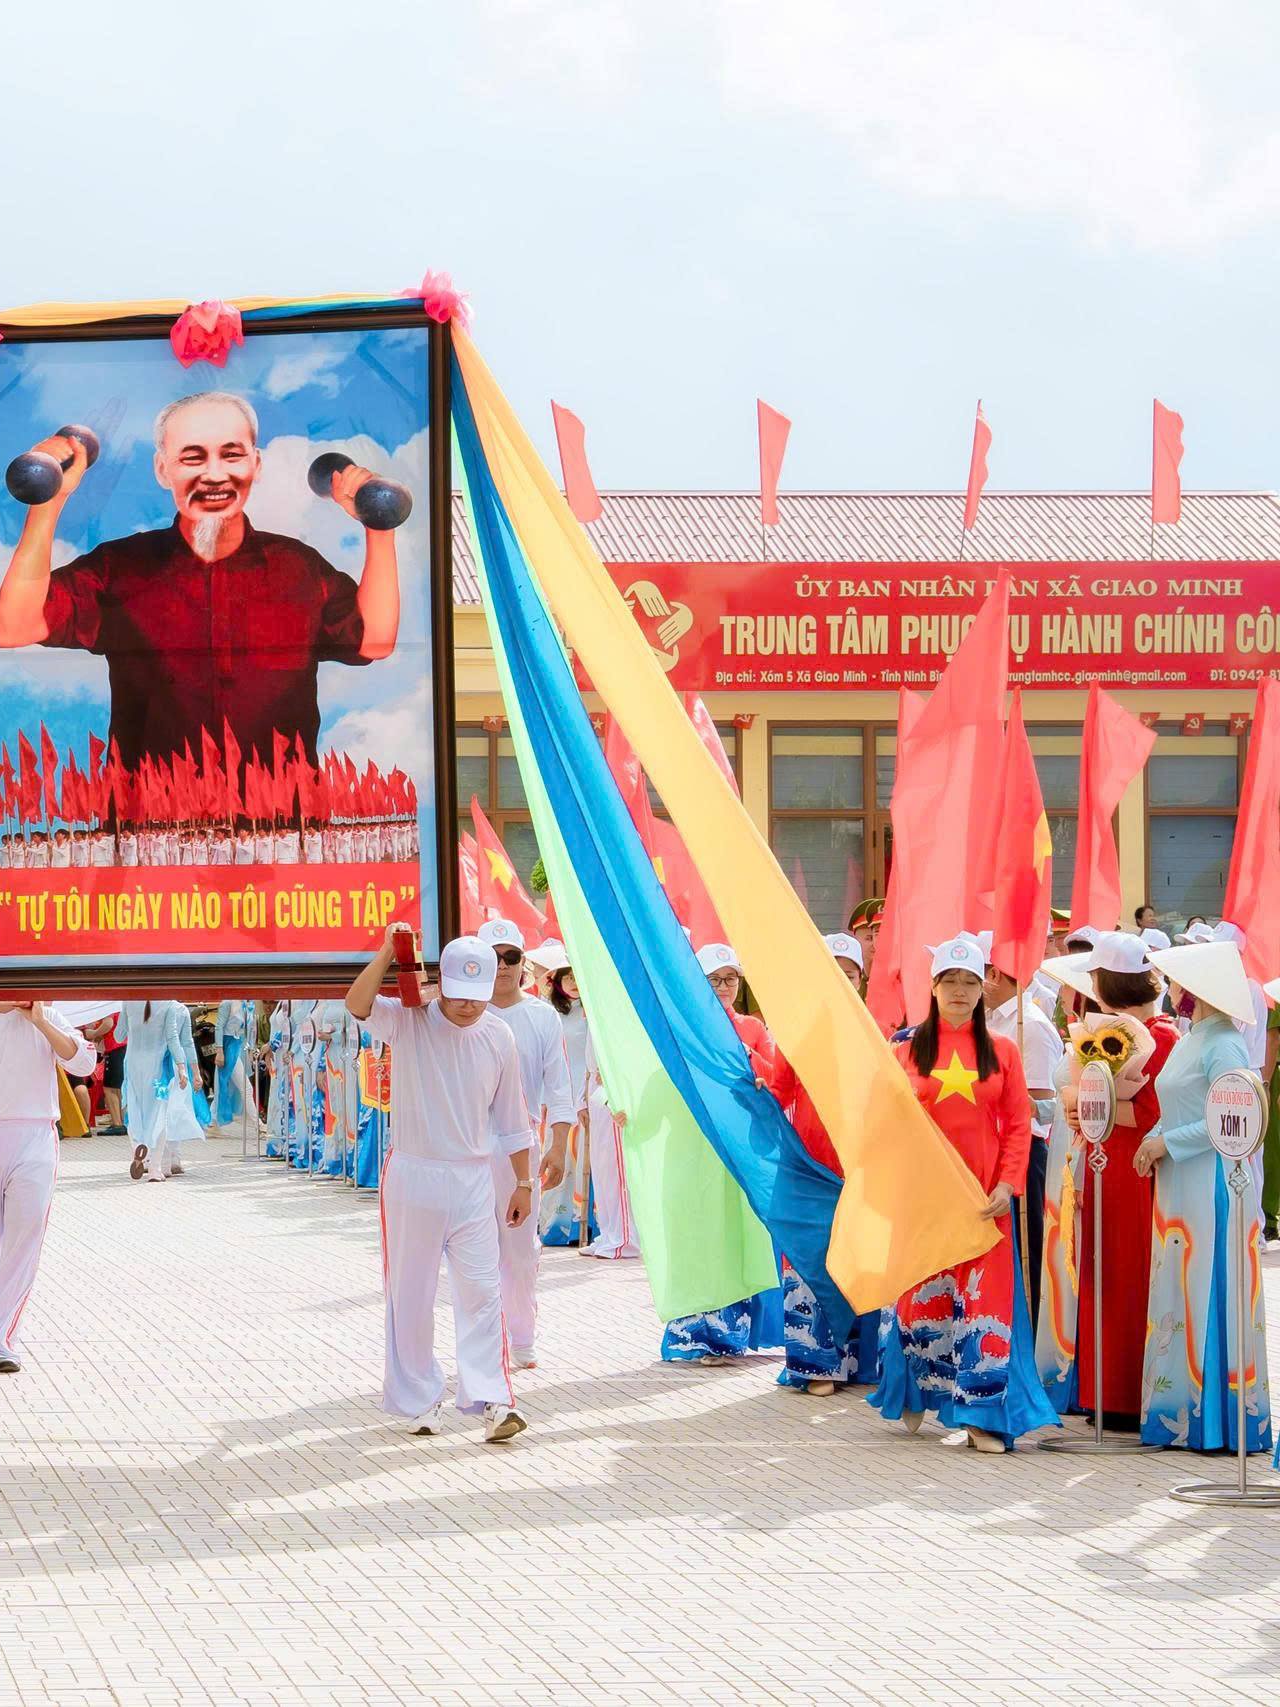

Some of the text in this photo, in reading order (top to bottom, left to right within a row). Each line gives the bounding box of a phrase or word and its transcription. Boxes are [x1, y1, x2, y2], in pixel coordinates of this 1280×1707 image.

[795, 574, 832, 598] ỦY
[837, 580, 891, 598] BAN
[900, 574, 976, 598] NHÂN
[1046, 575, 1084, 597] XÃ
[1090, 579, 1158, 597] GIAO
[1167, 579, 1243, 597] MINH
[719, 615, 817, 656] TRUNG
[826, 606, 889, 655] TÂM
[1007, 614, 1030, 663] Ụ
[1041, 606, 1123, 654] HÀNH
[1133, 606, 1225, 654] CHÍNH
[715, 671, 733, 686] Địa
[736, 669, 757, 683] chỉ:
[760, 670, 784, 683] Xóm
[786, 671, 794, 683] 5
[797, 671, 811, 683] Xã
[814, 671, 840, 683] Giao
[843, 670, 868, 683] Minh
[880, 669, 901, 682] Tỉnh
[904, 670, 927, 682] Ninh
[1210, 669, 1227, 681] ĐT:
[53, 886, 90, 932] TÔI
[98, 884, 163, 931] NGÀY
[171, 884, 221, 930] NÀO
[228, 883, 267, 929] TÔI
[274, 883, 342, 929] CŨNG
[1220, 1110, 1247, 1138] XÓM 1
